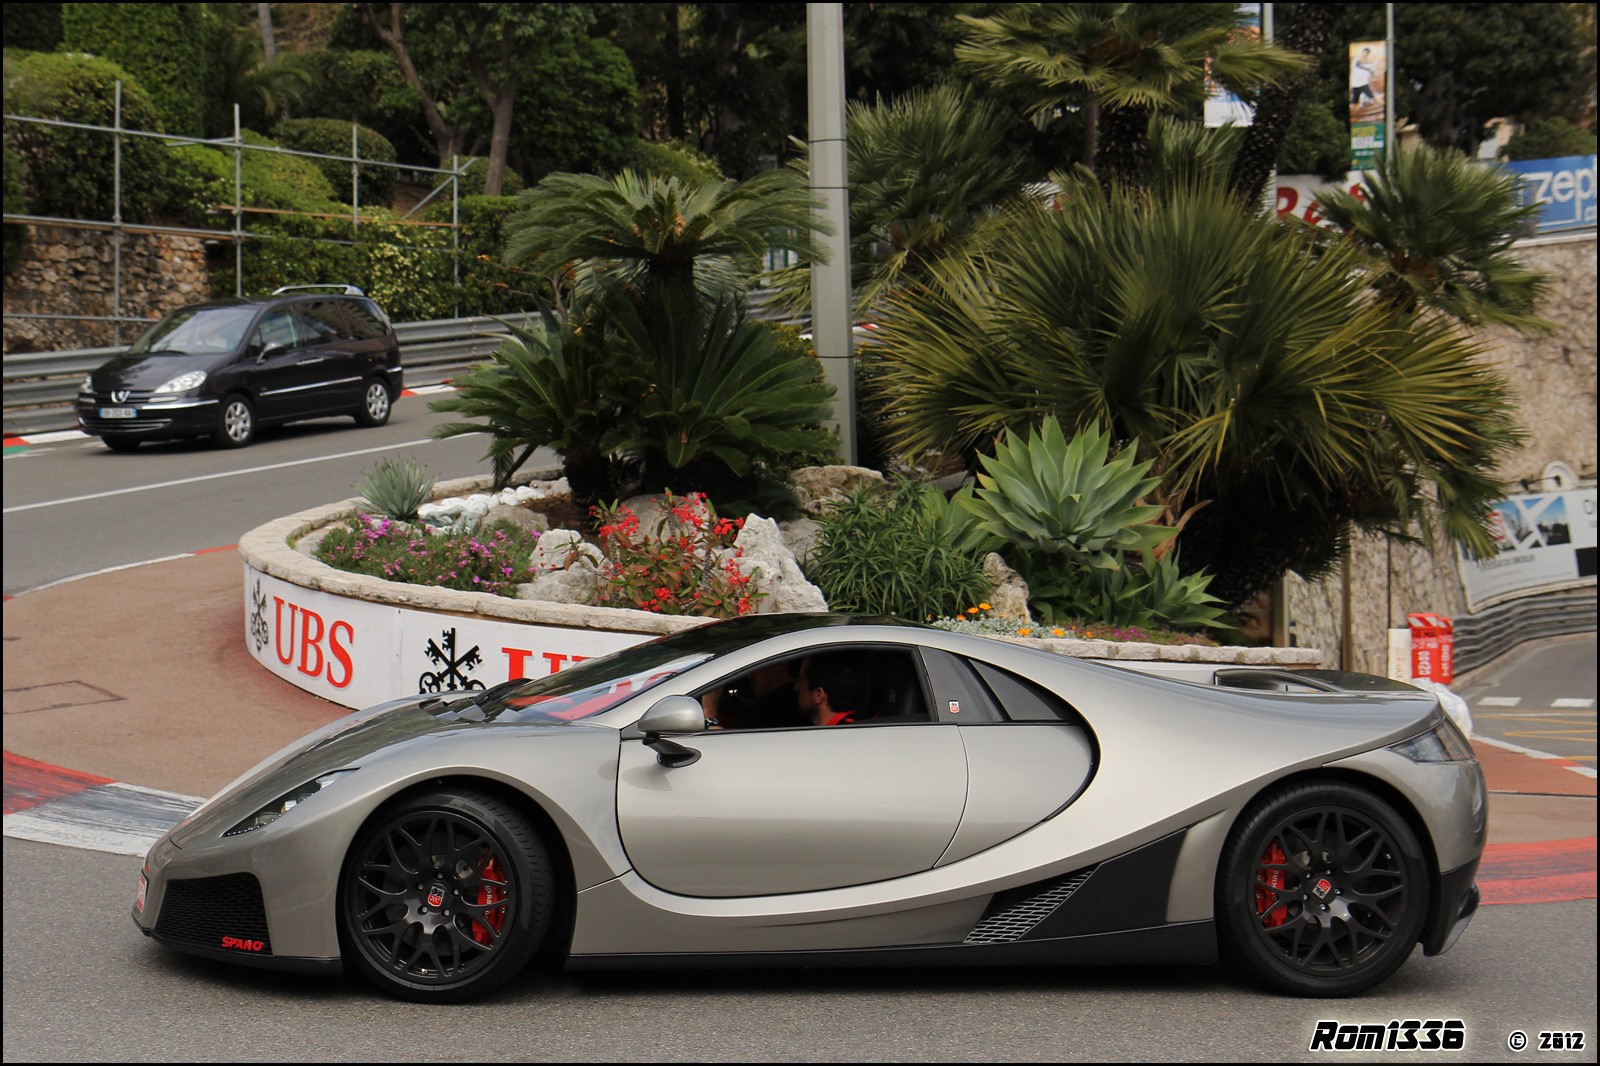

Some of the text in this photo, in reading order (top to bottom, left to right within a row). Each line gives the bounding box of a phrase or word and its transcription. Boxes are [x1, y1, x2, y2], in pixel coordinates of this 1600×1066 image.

[1519, 160, 1597, 222] zep
[273, 595, 354, 689] UBS
[221, 936, 263, 951] SPANO
